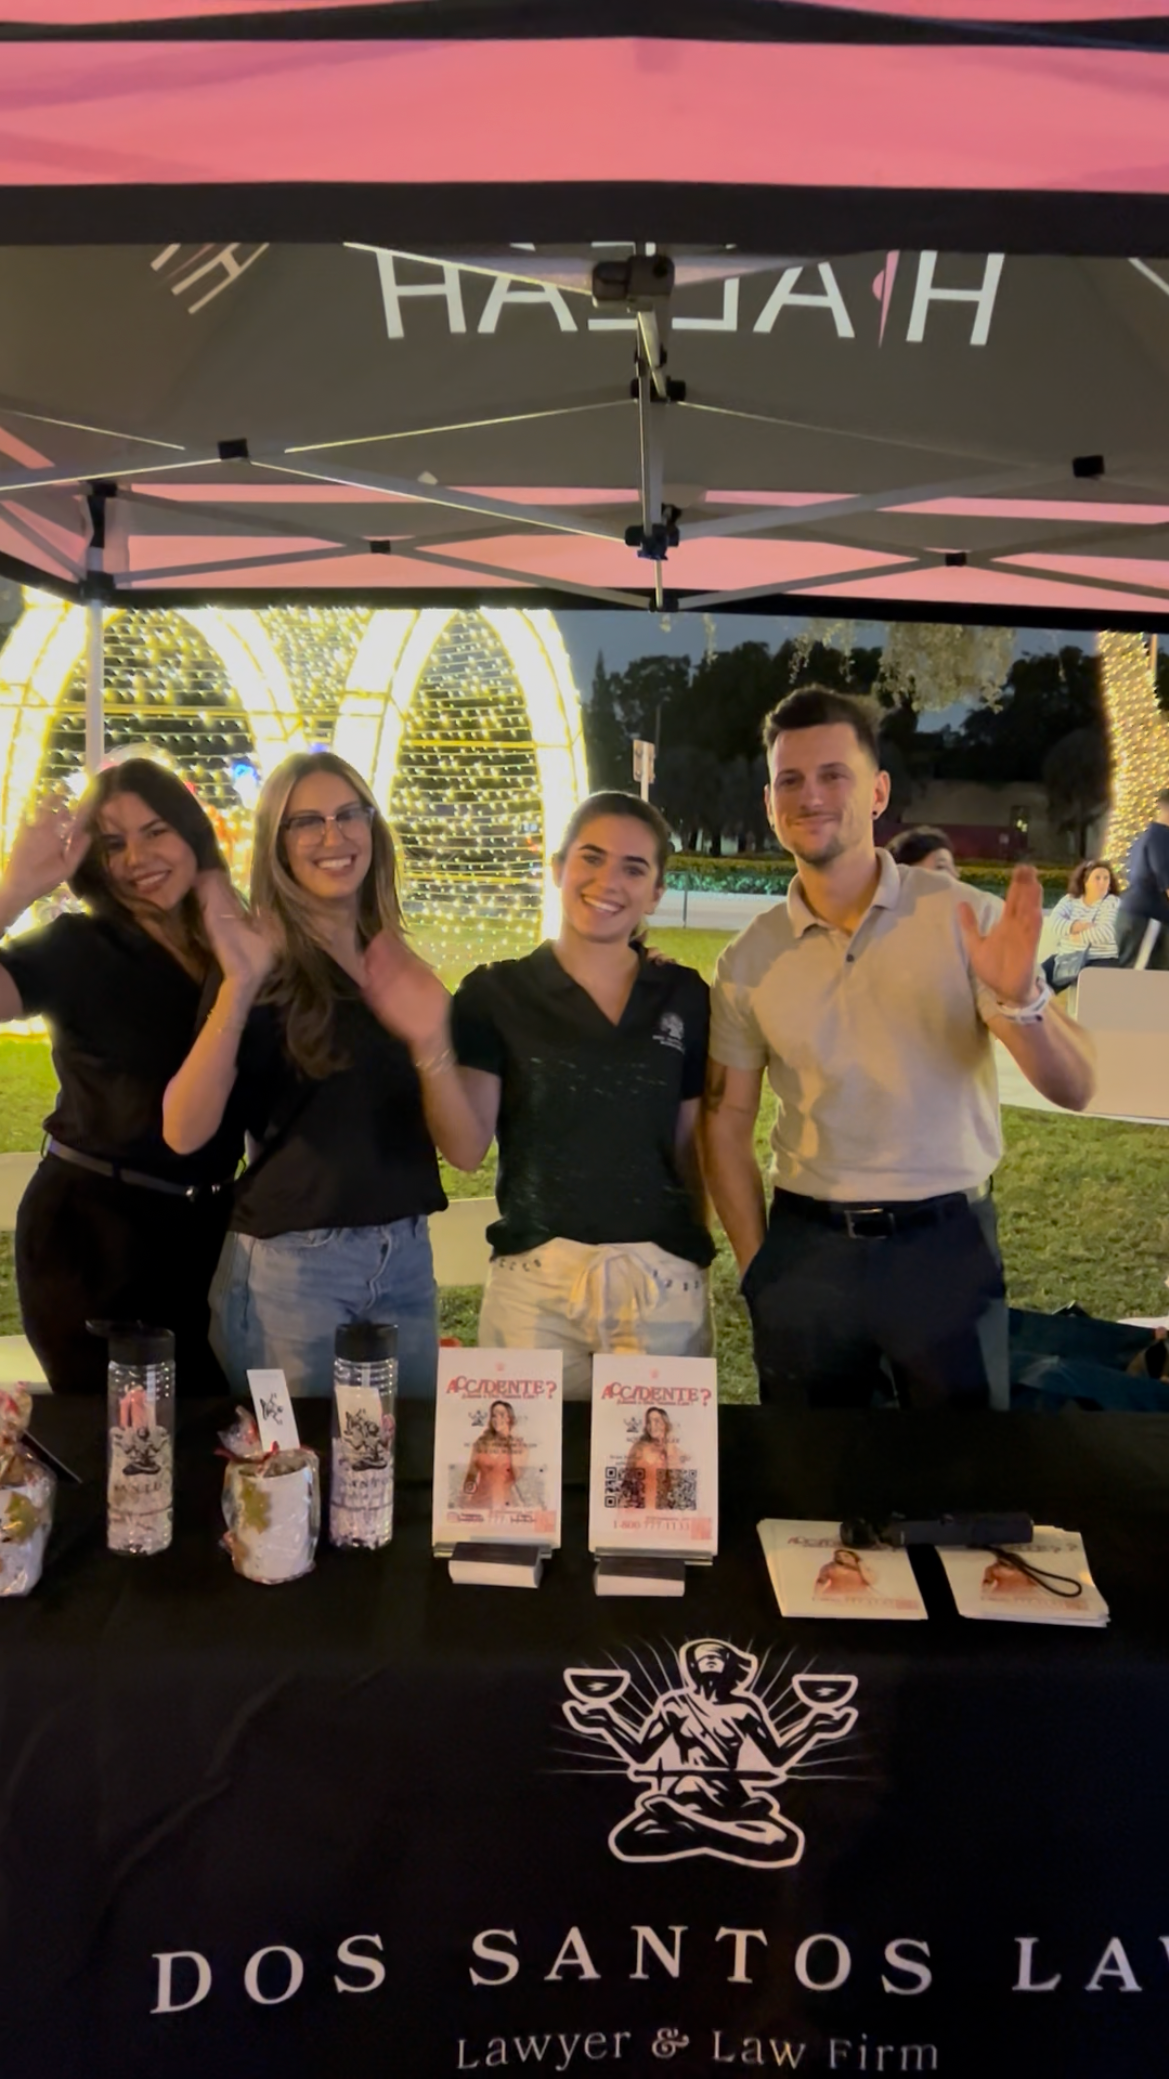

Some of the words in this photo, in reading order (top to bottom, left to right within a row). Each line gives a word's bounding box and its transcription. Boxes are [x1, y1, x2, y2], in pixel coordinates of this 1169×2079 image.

[446, 1375, 557, 1399] ACCIDENTE?
[601, 1381, 712, 1406] ACCIDENTE?
[150, 1933, 386, 2014] DOS
[469, 1925, 933, 1995] SANTOS
[457, 2030, 631, 2071] Lawyer
[651, 2027, 690, 2059] &
[713, 2030, 806, 2070] Law
[829, 2033, 938, 2071] Firm
